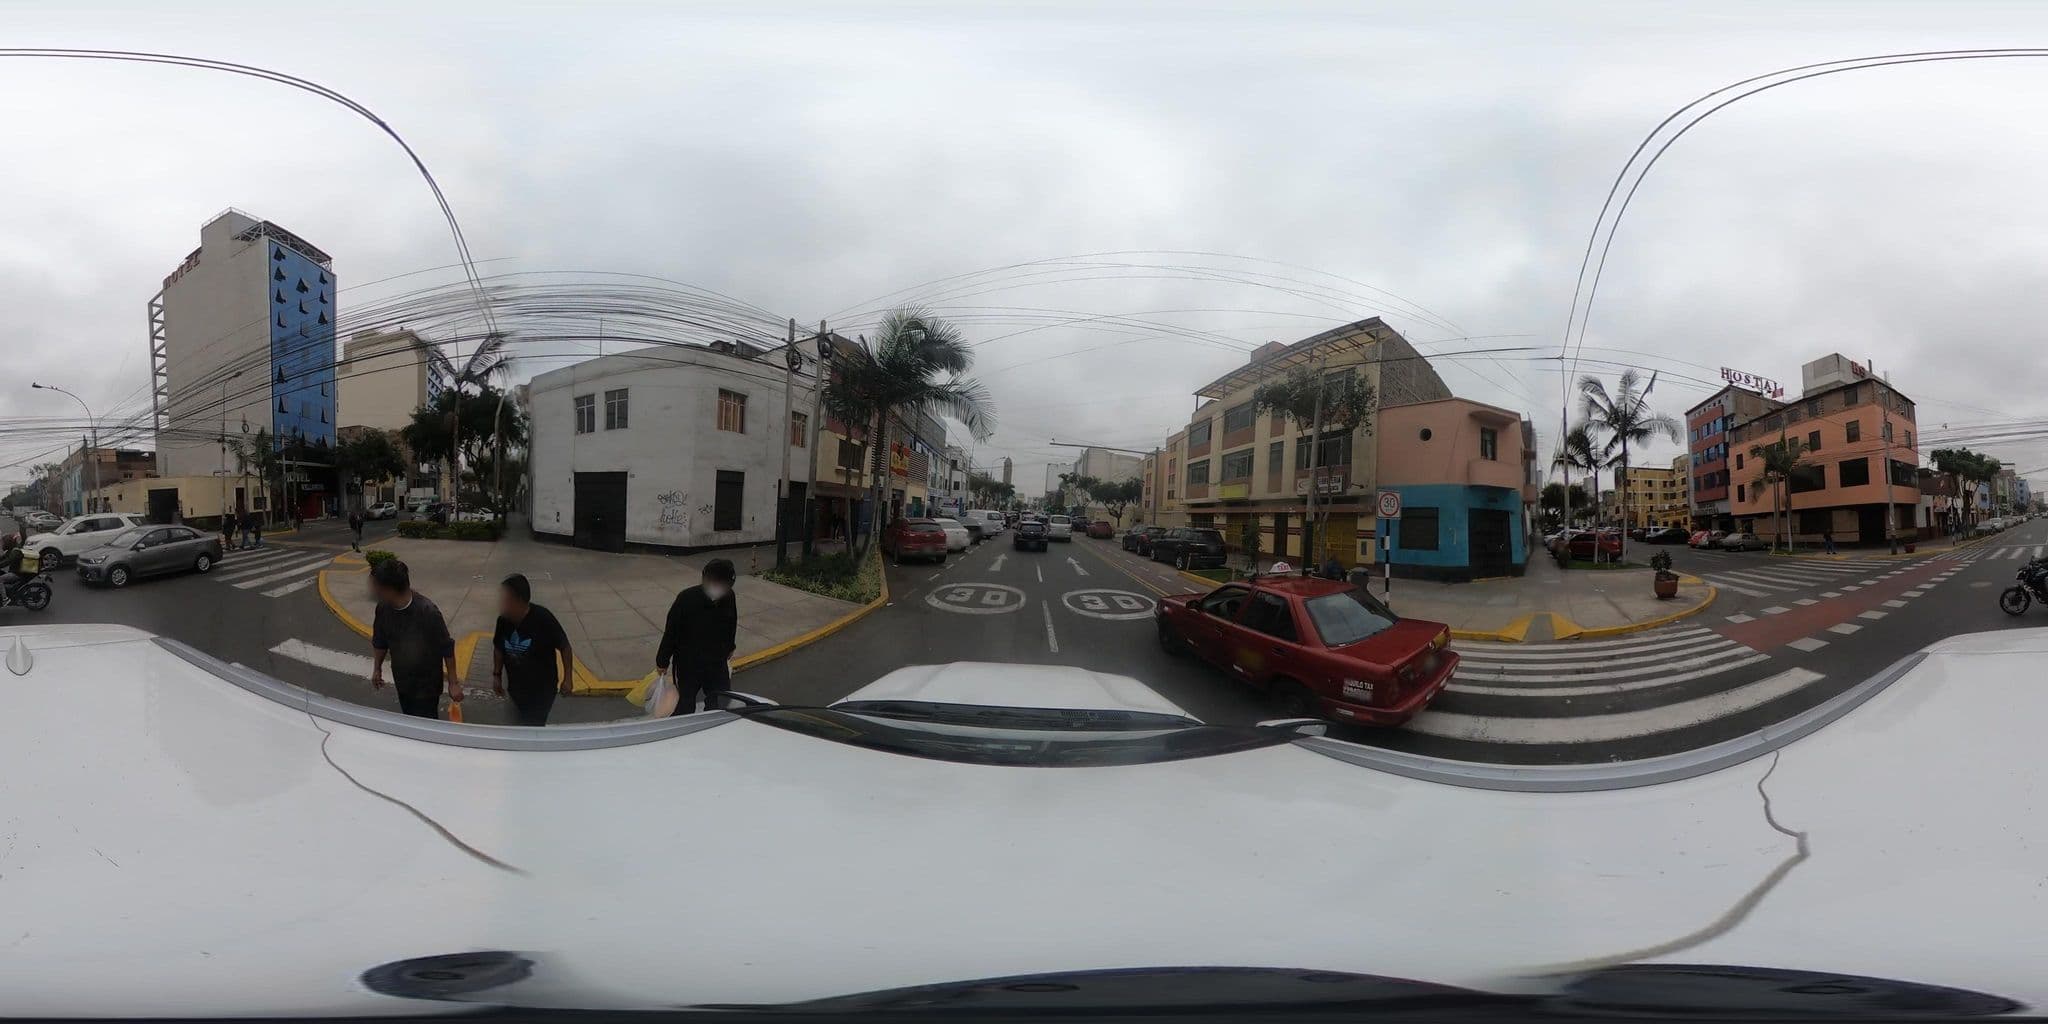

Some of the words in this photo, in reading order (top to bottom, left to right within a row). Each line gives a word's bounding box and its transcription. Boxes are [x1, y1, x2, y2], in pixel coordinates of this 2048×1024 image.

[1384, 497, 1395, 508] 30
[946, 587, 1008, 605] 30
[1080, 595, 1144, 610] 30
